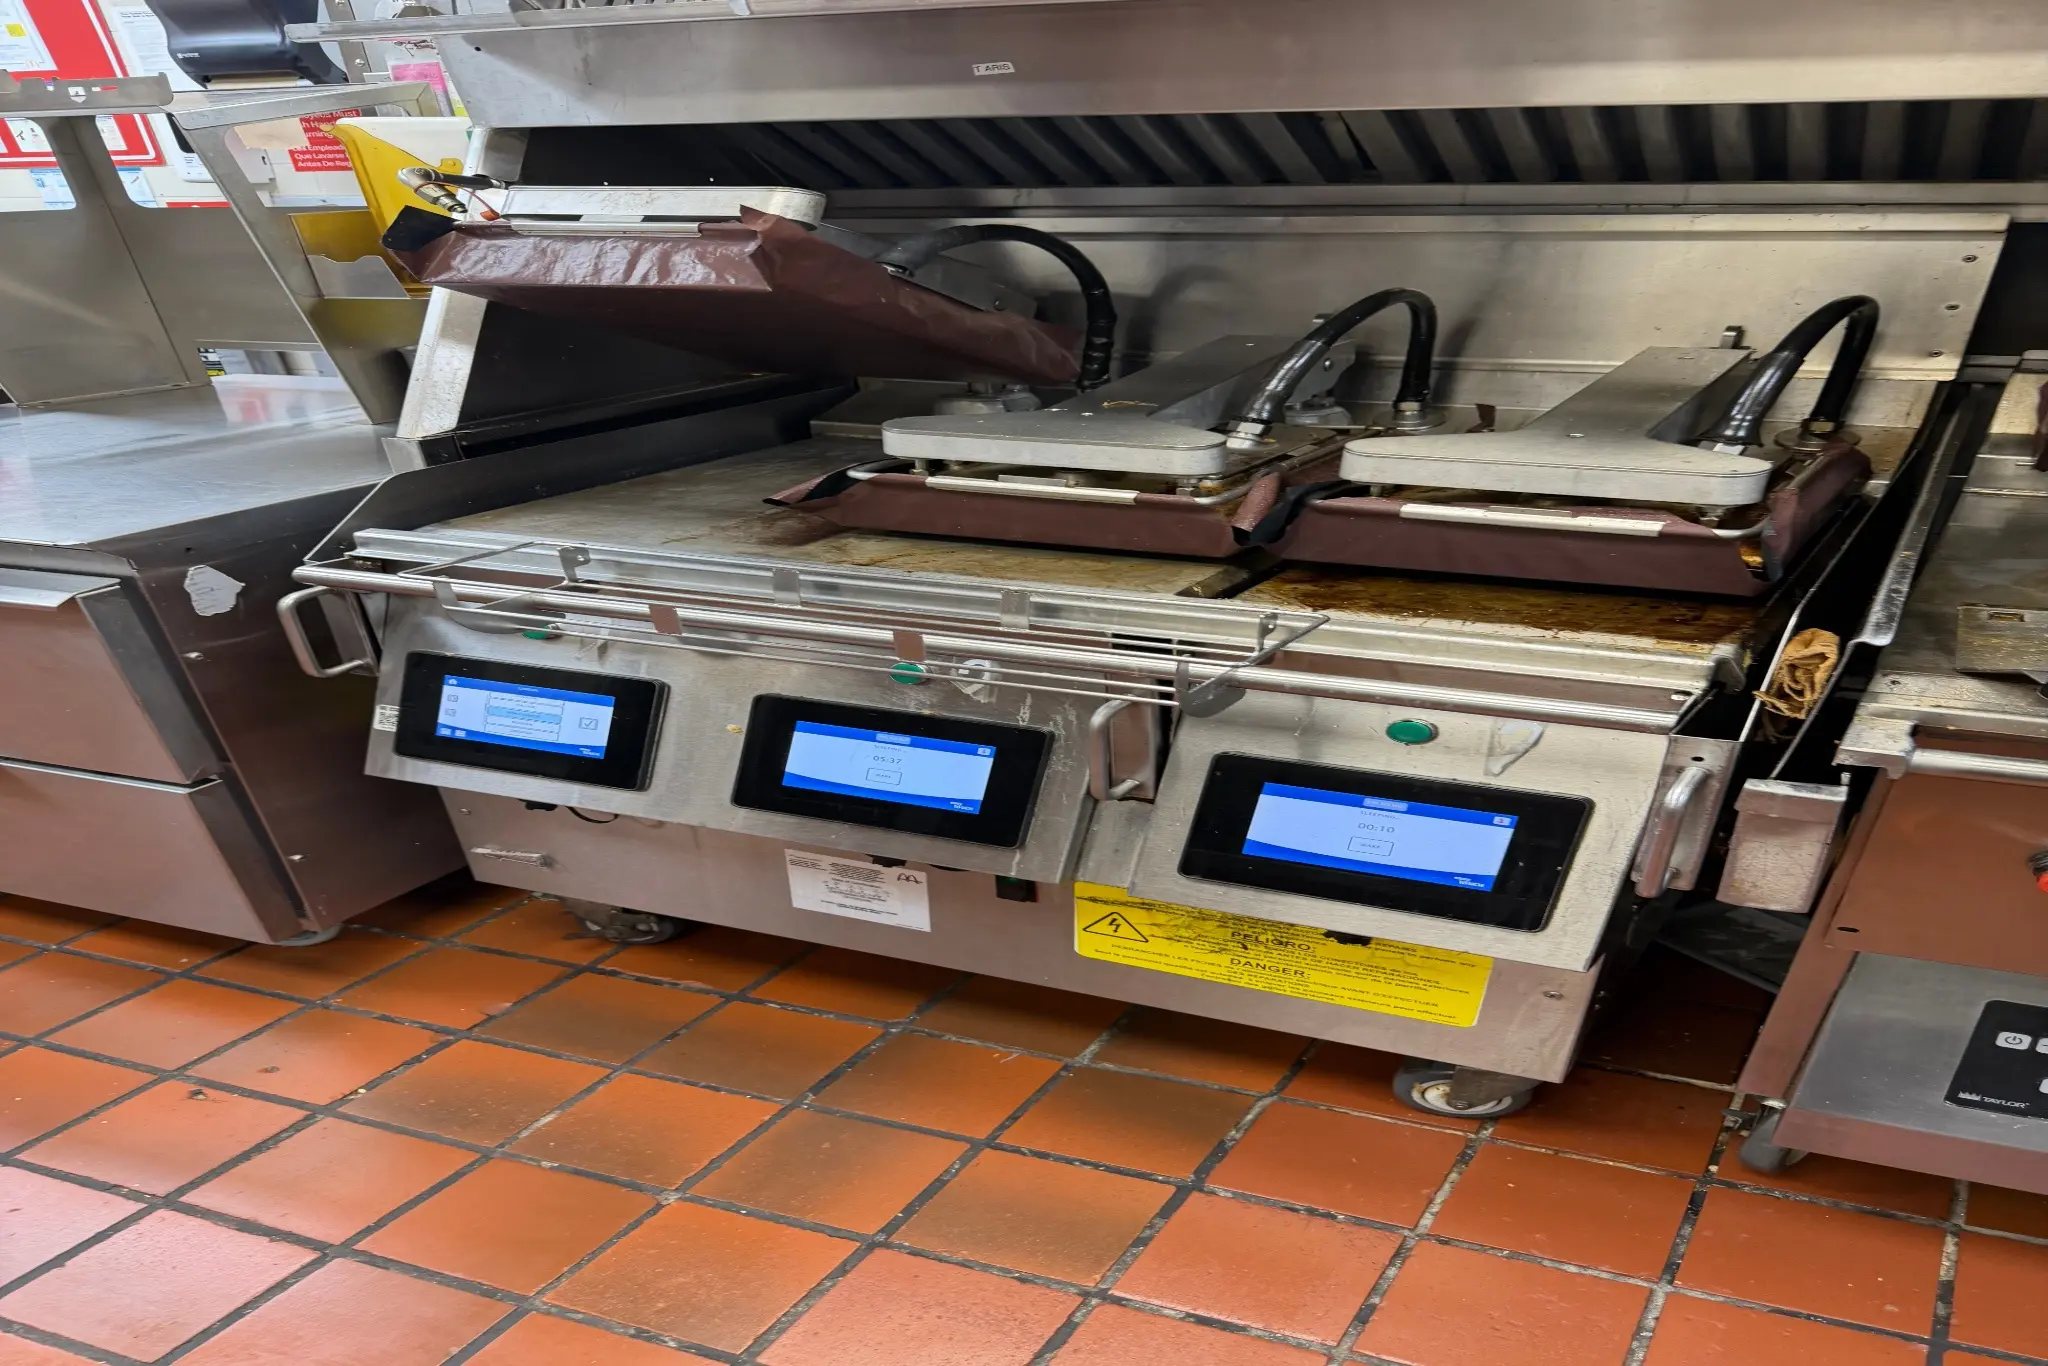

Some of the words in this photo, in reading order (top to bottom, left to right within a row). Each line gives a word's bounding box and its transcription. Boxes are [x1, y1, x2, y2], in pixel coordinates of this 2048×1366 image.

[332, 110, 357, 118] Must
[308, 144, 345, 152] Emplead
[873, 755, 902, 764] 05:37
[1358, 822, 1395, 833] 00:10
[1231, 931, 1316, 953] PELIGRO:
[1229, 957, 1311, 979] DANGER:
[1982, 1096, 2027, 1109] TAYLOR
